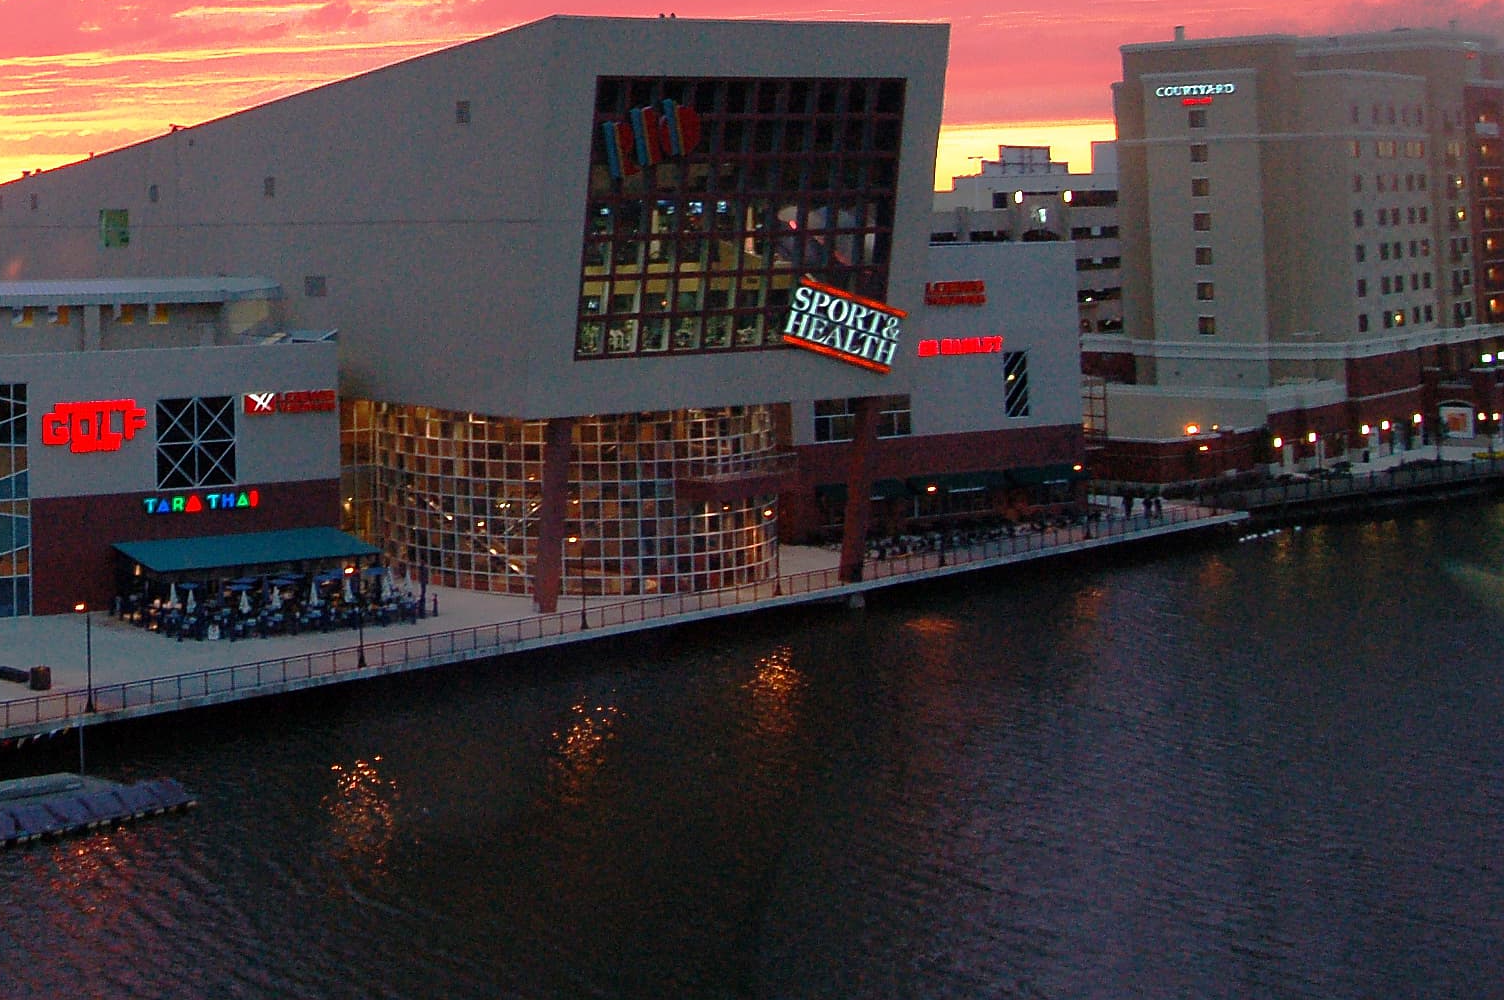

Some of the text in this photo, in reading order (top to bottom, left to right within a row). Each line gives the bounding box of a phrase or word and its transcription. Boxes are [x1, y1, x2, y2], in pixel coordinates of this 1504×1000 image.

[784, 309, 897, 365] HEALTH
[42, 399, 148, 453] GOLF
[143, 490, 259, 514] TARA THAI
